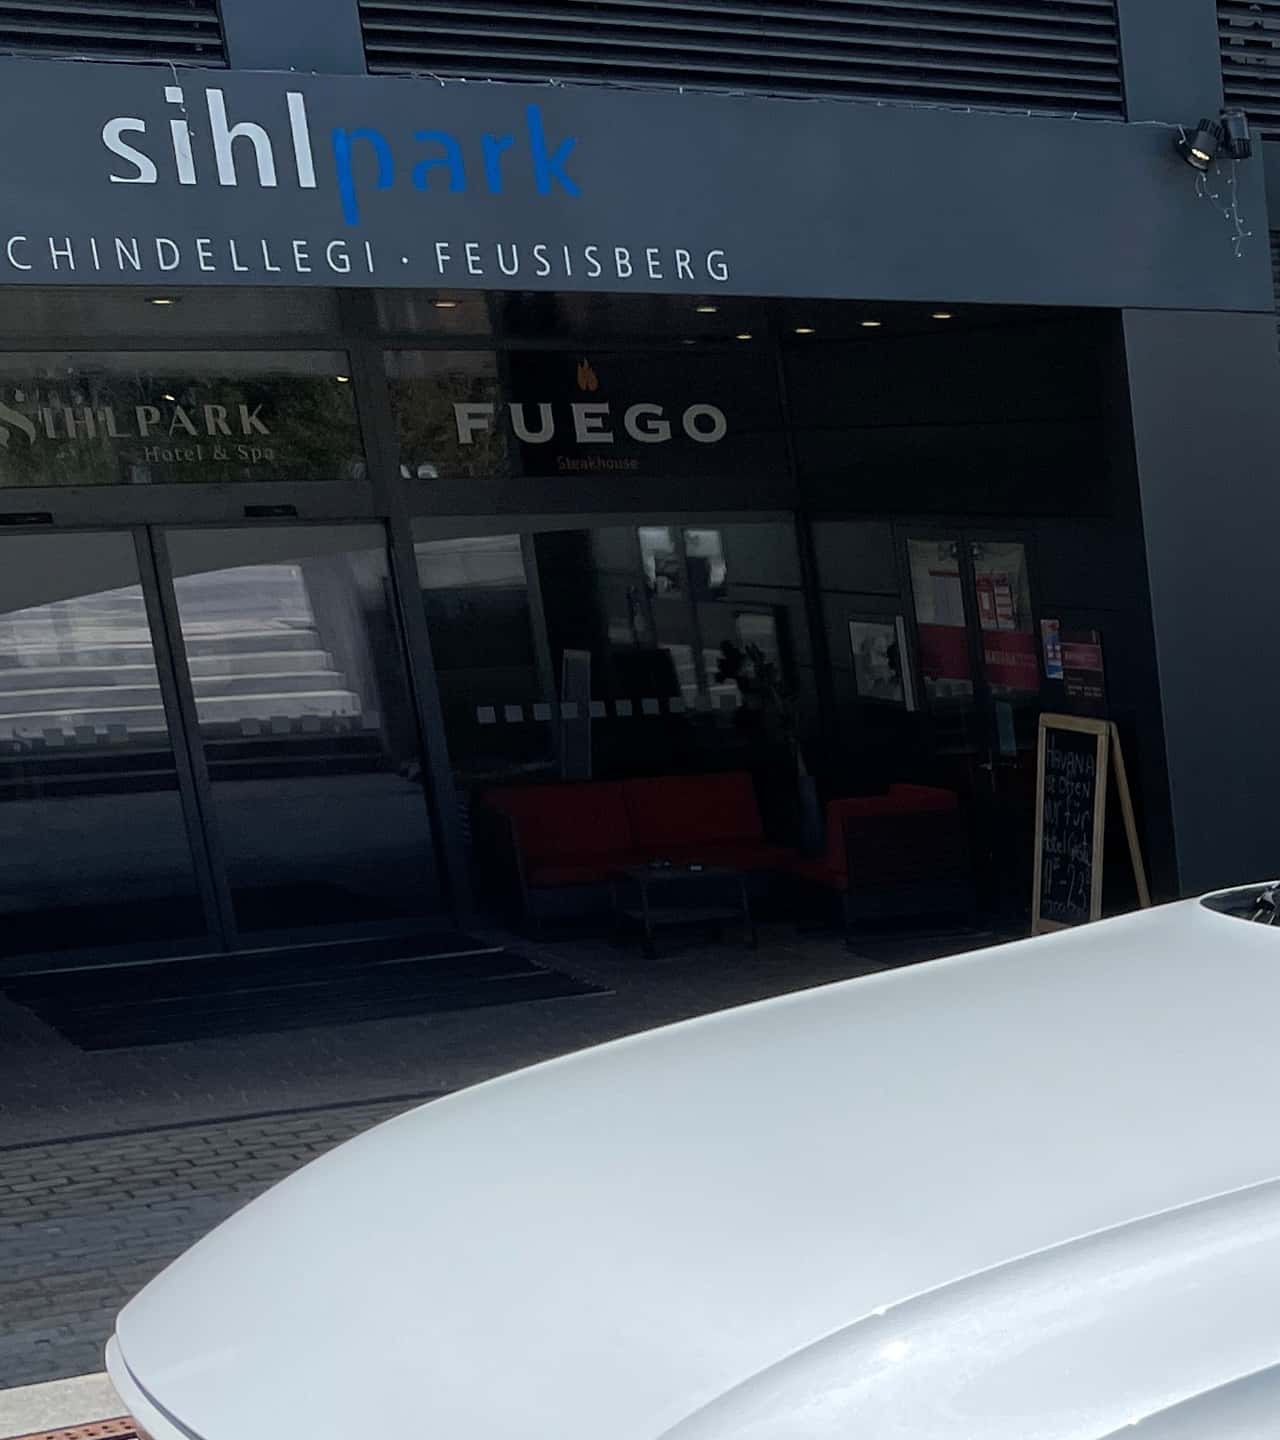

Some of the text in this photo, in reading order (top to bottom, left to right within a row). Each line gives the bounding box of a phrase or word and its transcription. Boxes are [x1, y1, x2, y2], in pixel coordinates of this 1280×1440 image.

[101, 86, 583, 226] sihlpark
[6, 234, 375, 273] CHINDELLEGI
[434, 241, 730, 282] FEUSISBERG
[451, 400, 728, 445] FUEGO
[144, 445, 203, 462] Hotel
[237, 444, 274, 465] Spa
[556, 455, 640, 473] Steakhouse
